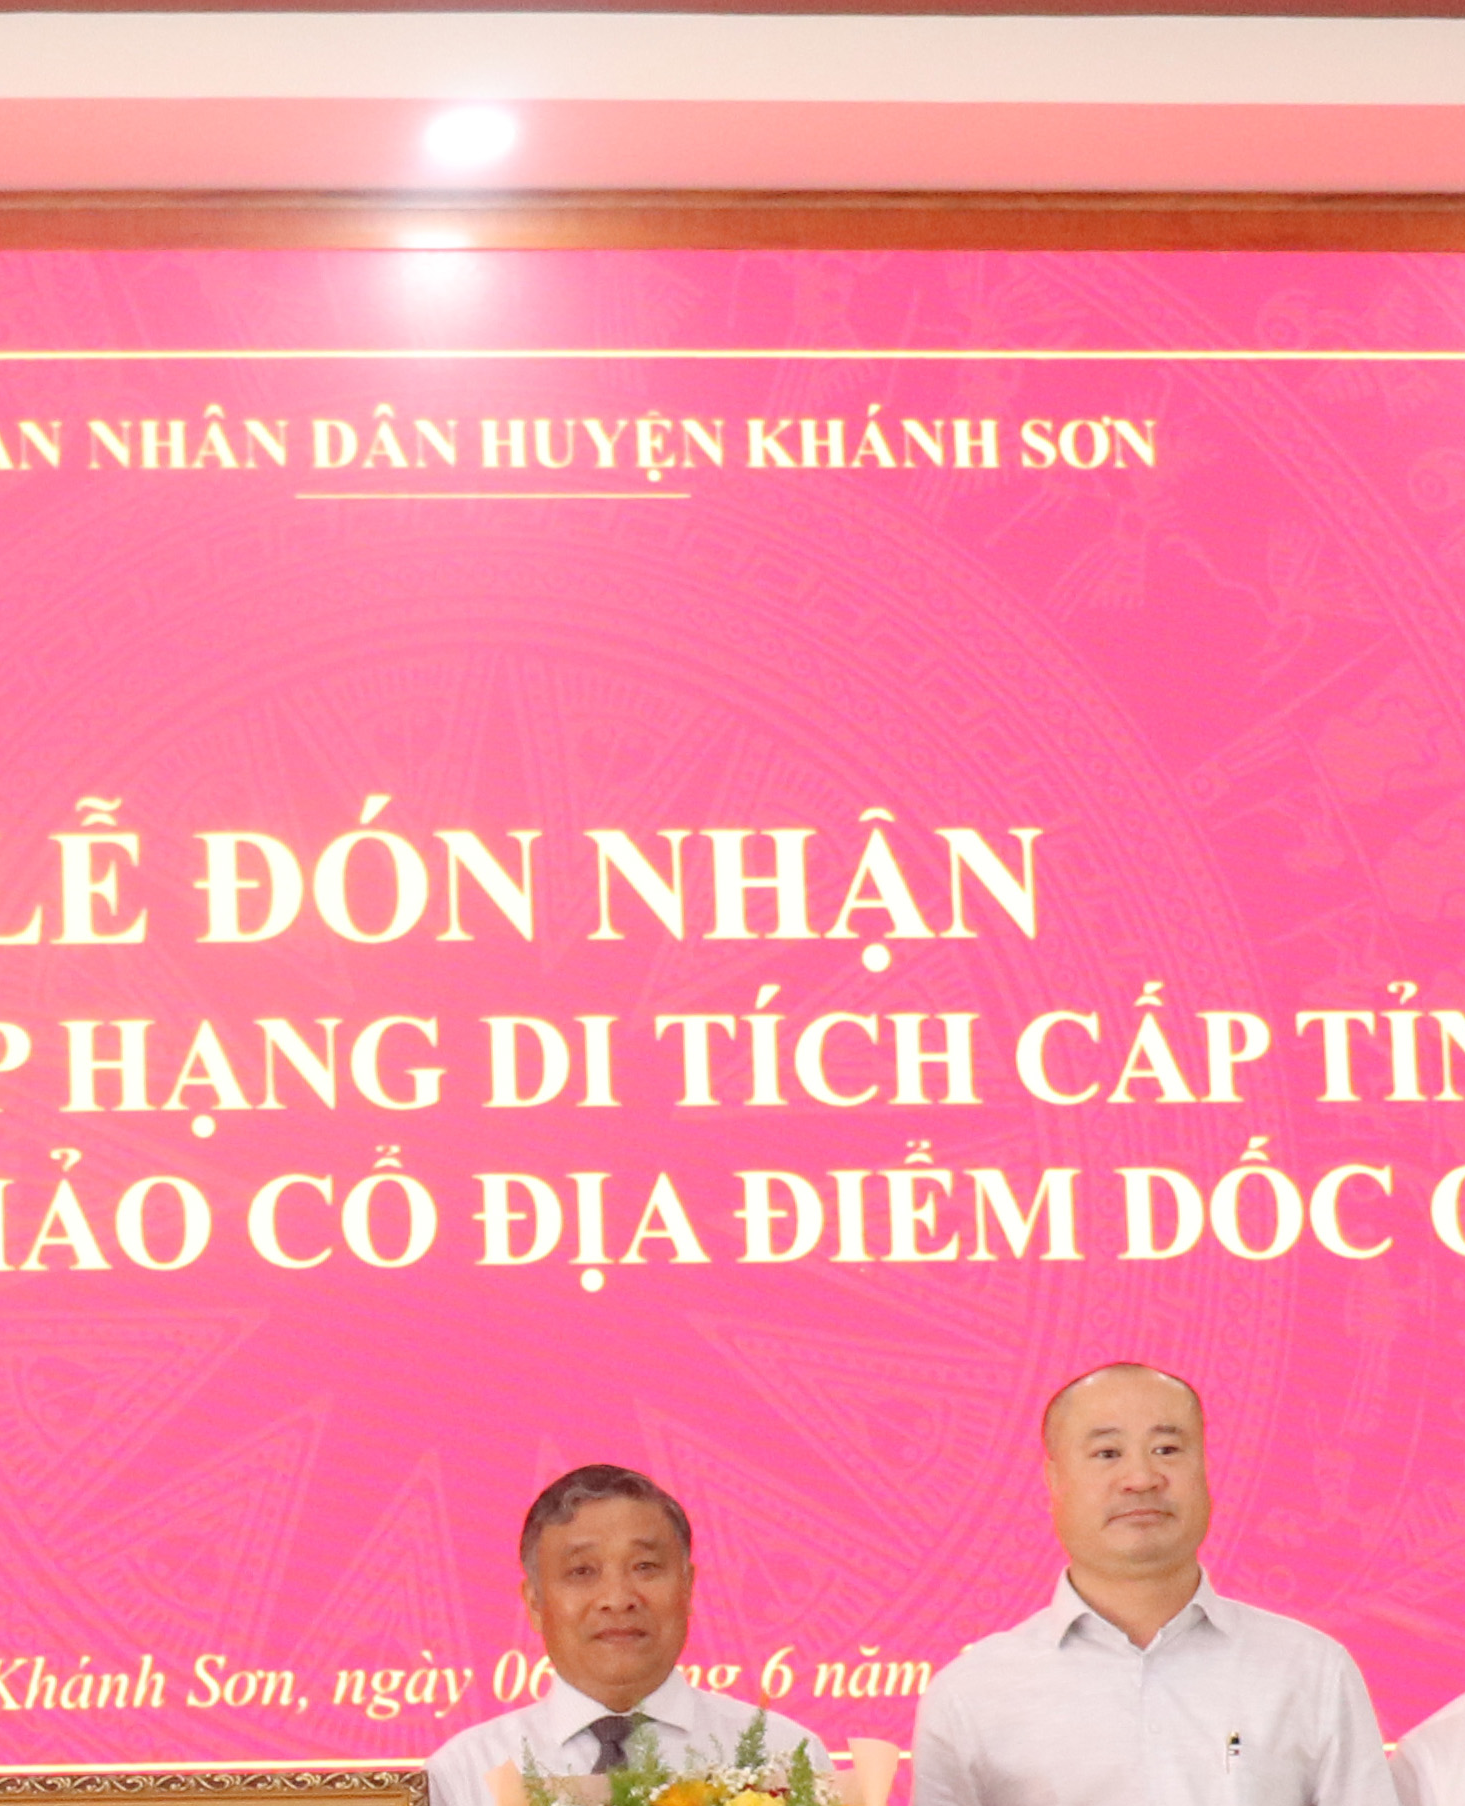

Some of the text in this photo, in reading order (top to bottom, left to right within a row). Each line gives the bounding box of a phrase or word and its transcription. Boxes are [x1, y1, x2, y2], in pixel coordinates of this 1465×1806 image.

[86, 402, 291, 471] NHÂN
[310, 399, 461, 471] DÂN
[476, 409, 725, 484] HUYỆN
[746, 402, 1001, 470] KHÁNH
[1019, 414, 1156, 470] SƠN
[192, 792, 544, 945] ĐÓN
[583, 804, 1044, 975] NHẬN
[58, 1014, 447, 1140] HẠNG
[480, 1013, 621, 1109] DI
[654, 983, 983, 1108] TÍCH
[1014, 980, 1272, 1106] CẤP
[246, 1144, 439, 1270] CỔ
[472, 1170, 712, 1293] ĐỊA
[732, 1139, 1084, 1264] ĐIỂM
[1115, 1135, 1393, 1261] DỐC
[186, 1653, 309, 1712] Sơn,
[332, 1649, 474, 1720] ngày
[760, 1645, 795, 1699] 6
[813, 1645, 933, 1699] năm
